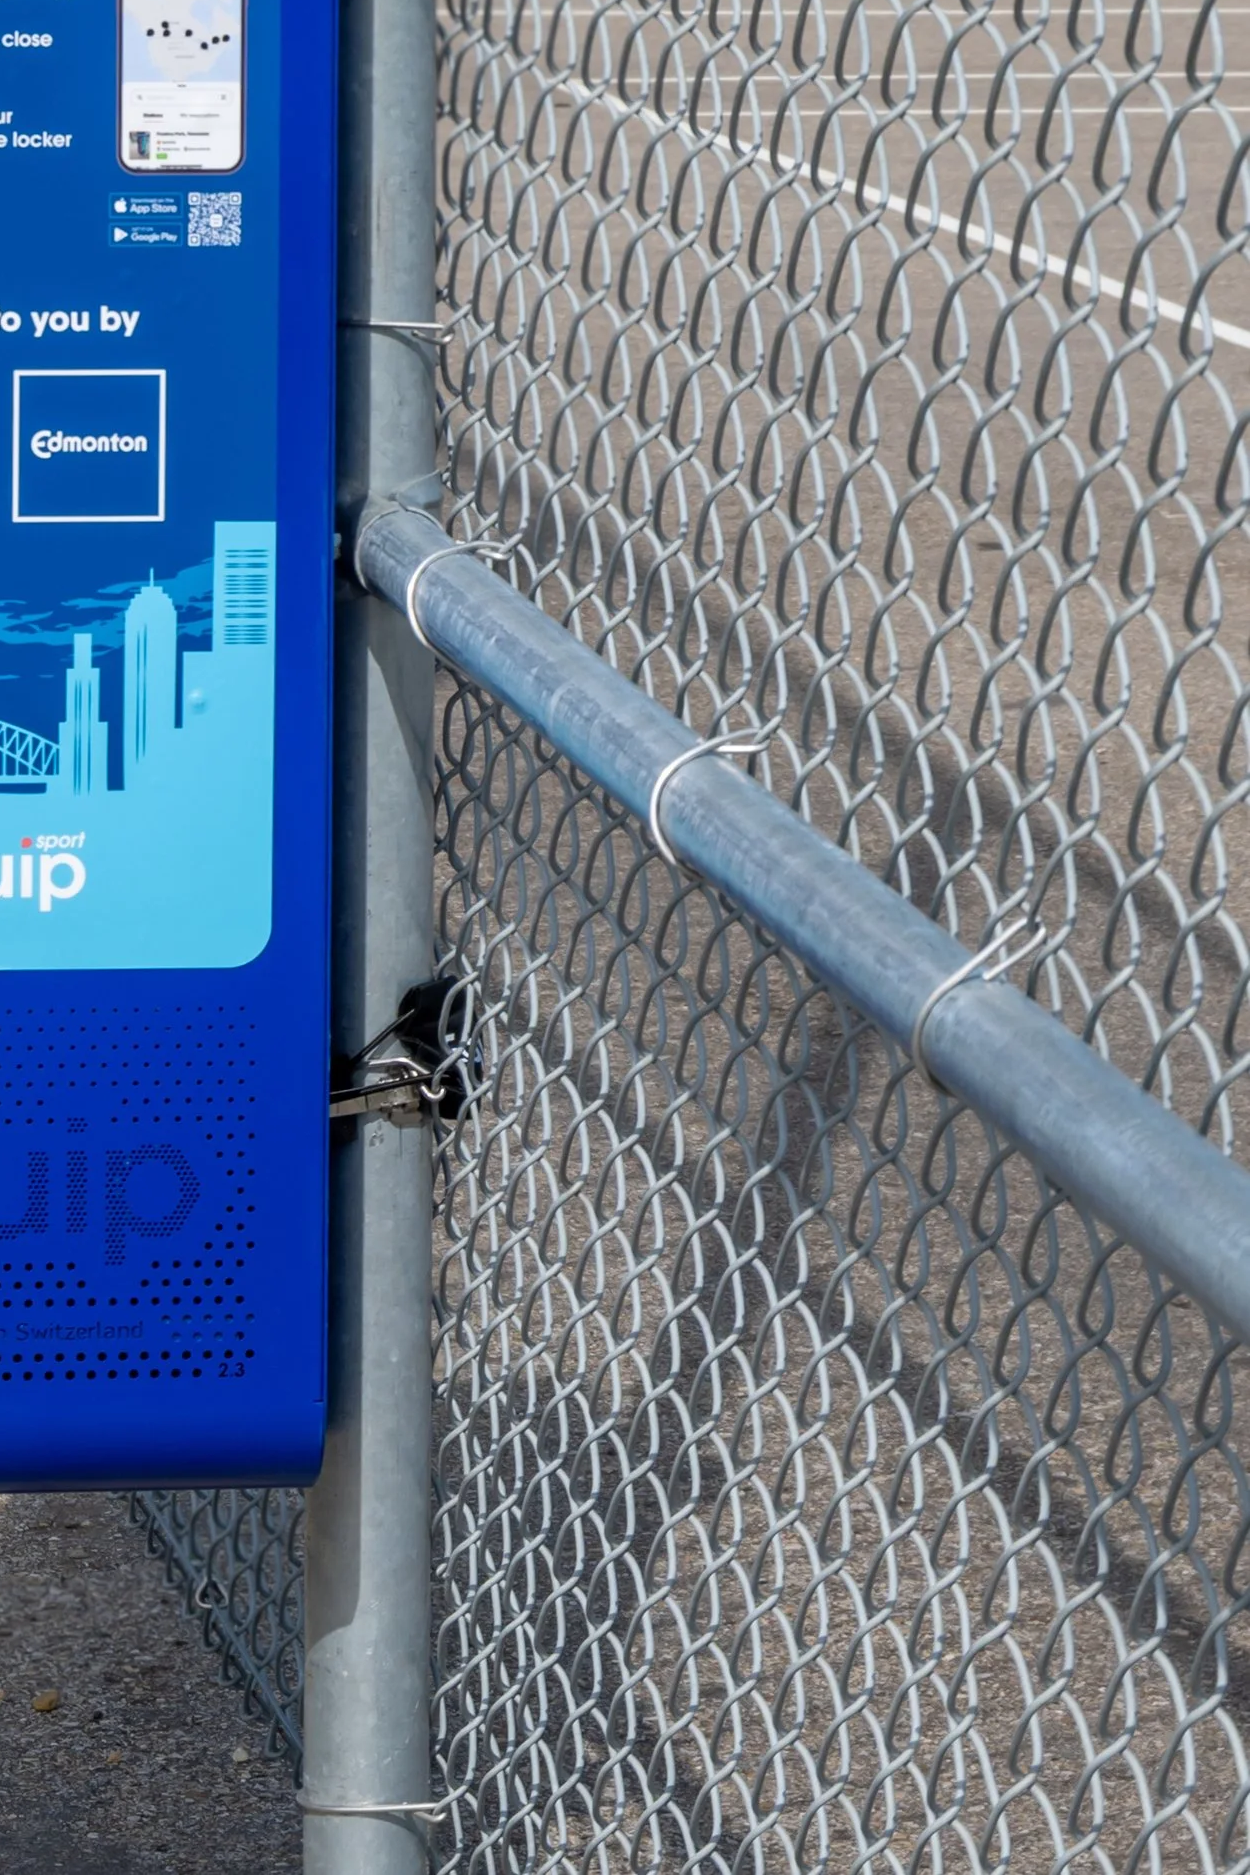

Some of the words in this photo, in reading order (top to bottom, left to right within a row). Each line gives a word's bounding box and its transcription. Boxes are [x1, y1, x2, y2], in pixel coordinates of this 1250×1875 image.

[2, 31, 53, 47] close
[13, 131, 72, 147] locker
[130, 203, 150, 215] App
[151, 204, 177, 213] Store
[130, 232, 160, 243] Google
[161, 232, 178, 242] Play
[30, 311, 89, 337] you
[100, 305, 140, 337] by
[31, 430, 147, 459] Edmonton
[35, 832, 86, 851] sport
[15, 1321, 144, 1342] Switzerland
[218, 1363, 246, 1378] 2.3
